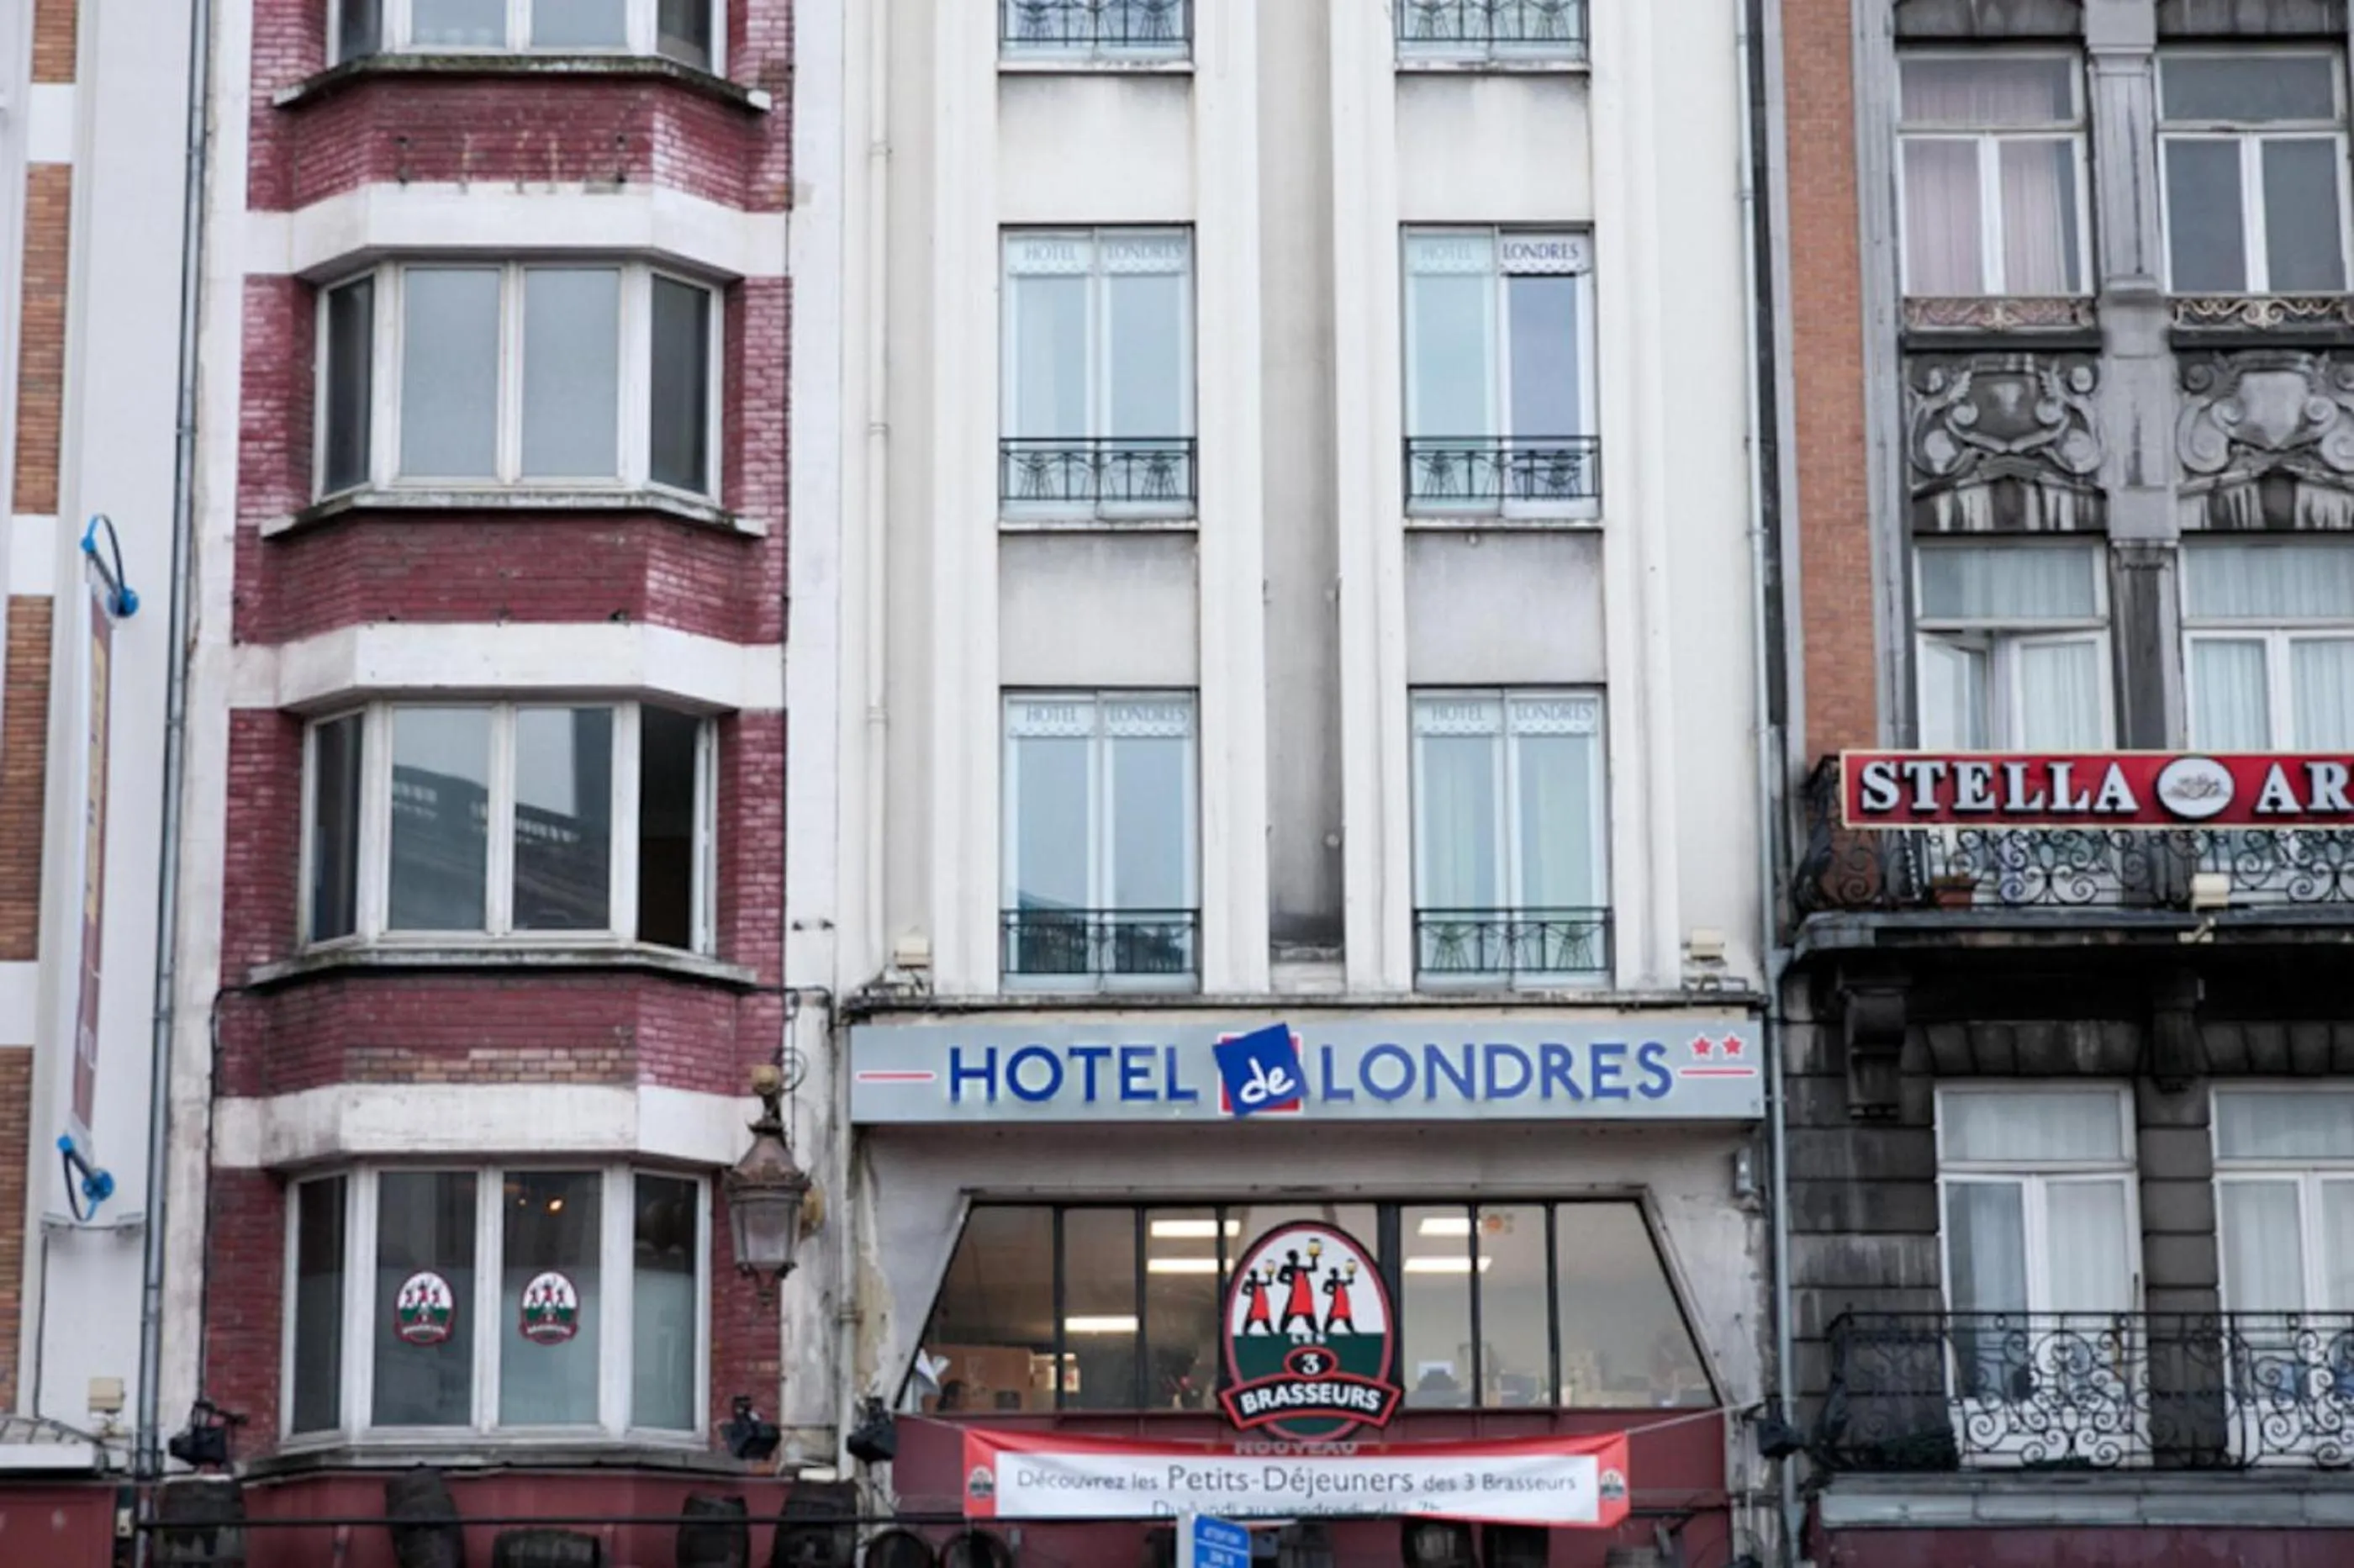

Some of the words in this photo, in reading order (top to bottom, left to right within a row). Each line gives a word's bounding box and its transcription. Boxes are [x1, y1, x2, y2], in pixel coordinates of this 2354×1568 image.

[1502, 242, 1579, 260] LONDRES
[1861, 761, 2139, 814] STELLA
[949, 1045, 1199, 1104] HOTEL
[1240, 1057, 1295, 1104] de
[1320, 1041, 1673, 1102] LONDRES
[1302, 1353, 1321, 1375] 3
[1239, 1383, 1382, 1415] BRASSEURS
[1016, 1468, 1126, 1490] Découvrez
[1131, 1471, 1159, 1491] les
[1167, 1465, 1414, 1498] Petits-Déjeuners
[1422, 1474, 1456, 1491] des
[1463, 1473, 1476, 1491] 3
[1481, 1472, 1576, 1492] Brasseurs
